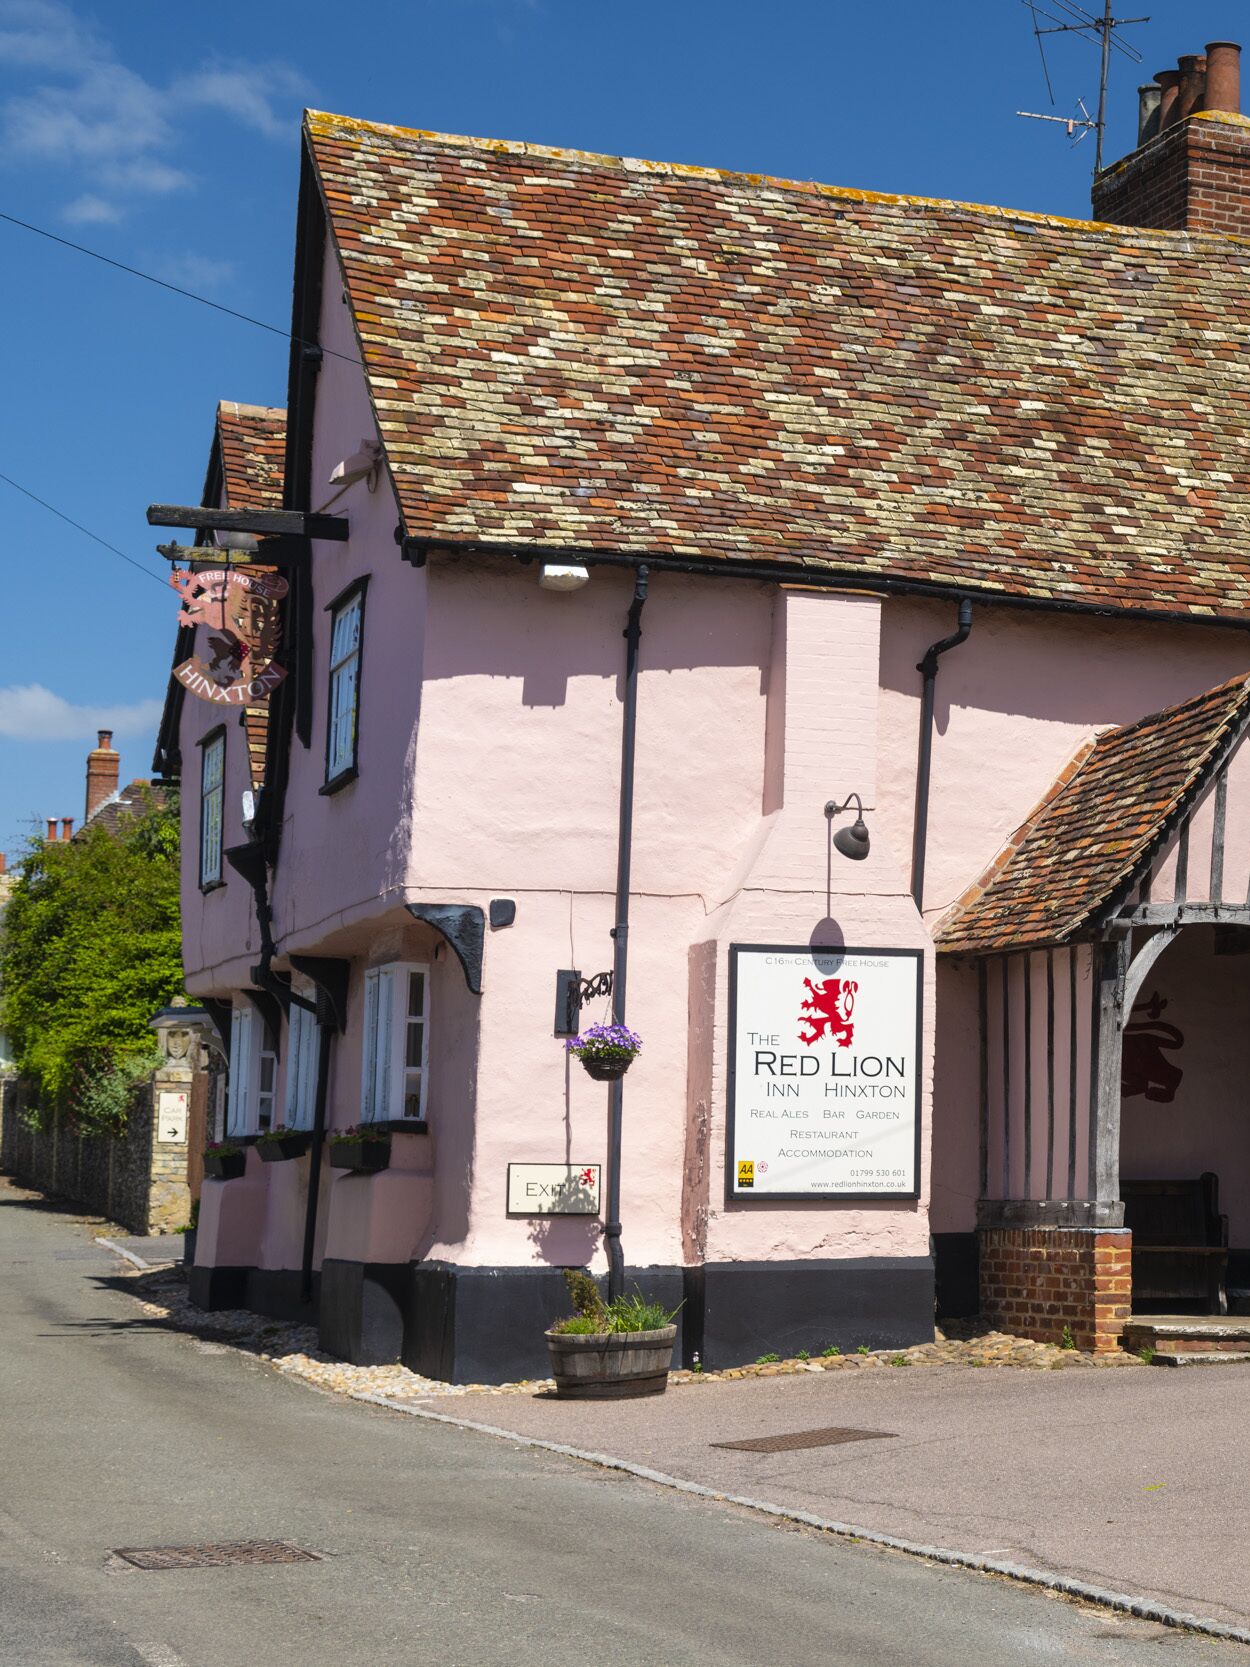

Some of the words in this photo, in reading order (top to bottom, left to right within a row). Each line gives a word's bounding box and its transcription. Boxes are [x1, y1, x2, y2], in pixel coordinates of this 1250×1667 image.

[198, 571, 231, 583] FREE
[233, 573, 272, 597] HOUSE
[180, 663, 281, 702] HINXTON
[794, 958, 835, 966] CENTURY
[836, 958, 858, 967] FREE
[859, 959, 889, 968] HOUSE
[746, 1032, 780, 1046] THE
[754, 1050, 820, 1077] RED
[831, 1052, 905, 1078] LION
[767, 1081, 800, 1097] INN
[824, 1082, 906, 1098] HINXTON
[750, 1108, 778, 1119] REAL
[781, 1109, 809, 1119] ALES
[823, 1109, 845, 1119] BAR
[856, 1110, 900, 1120] GARDEN
[790, 1129, 859, 1139] RESTAURANT
[778, 1148, 873, 1158] ACCOMMODATION
[740, 1164, 753, 1174] AA
[850, 1169, 874, 1177] 01799
[875, 1169, 890, 1177] 530
[892, 1169, 906, 1177] 601
[526, 1182, 567, 1197] EXIT
[810, 1180, 906, 1188] www.redlionhinxton.co.uk
